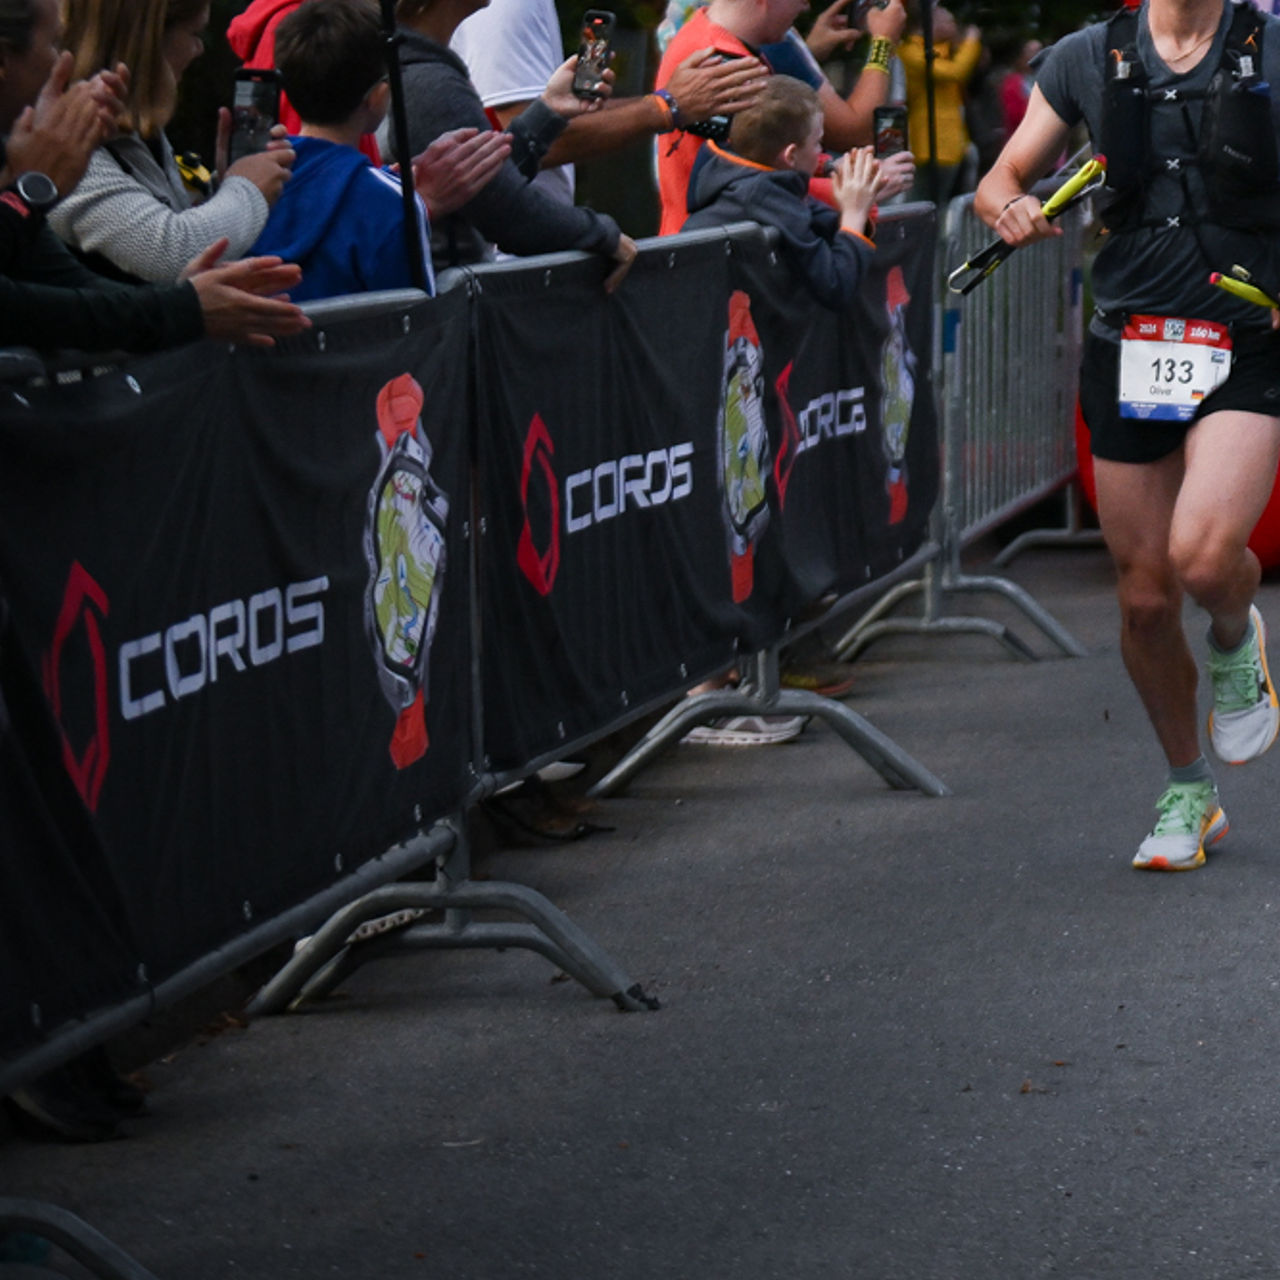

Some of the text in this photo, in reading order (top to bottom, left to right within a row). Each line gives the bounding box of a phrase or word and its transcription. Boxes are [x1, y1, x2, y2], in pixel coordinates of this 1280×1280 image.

[1151, 357, 1194, 385] 133
[564, 441, 695, 535] COROS
[118, 575, 330, 721] COROS
